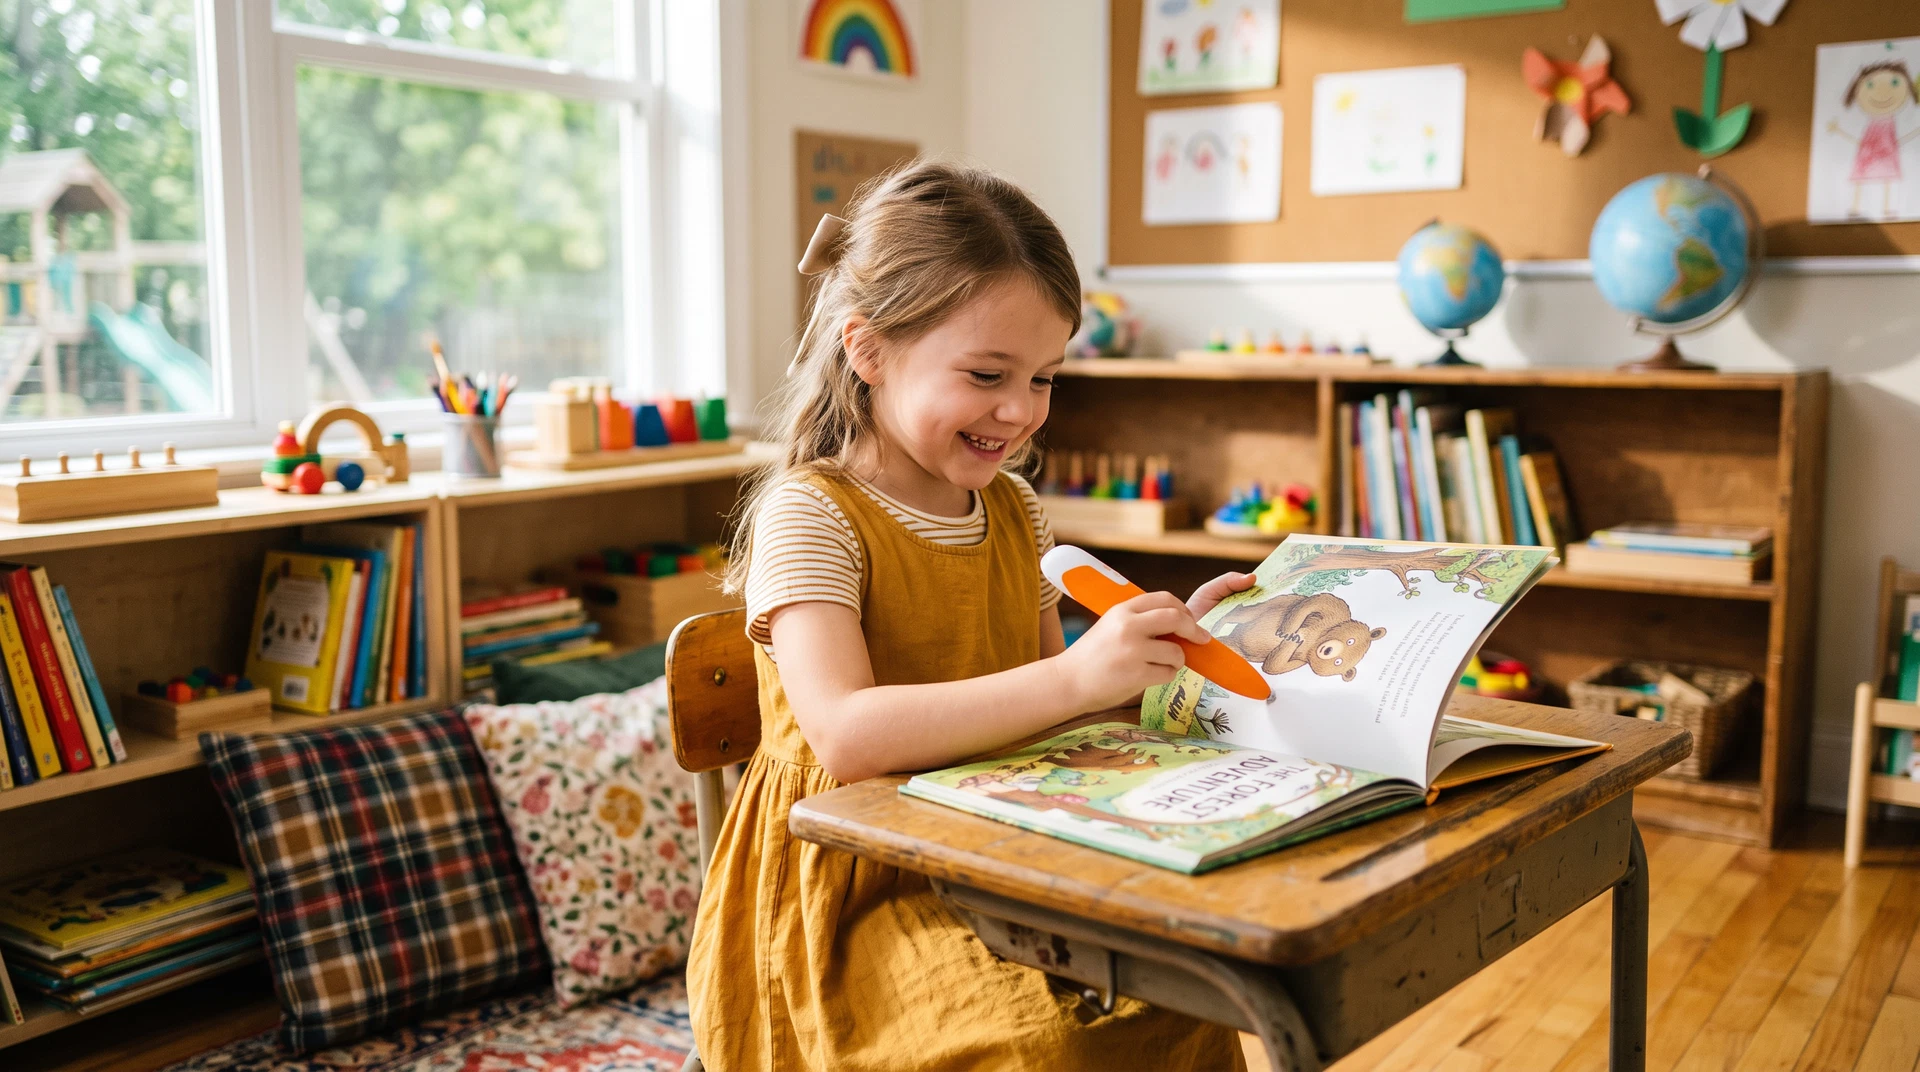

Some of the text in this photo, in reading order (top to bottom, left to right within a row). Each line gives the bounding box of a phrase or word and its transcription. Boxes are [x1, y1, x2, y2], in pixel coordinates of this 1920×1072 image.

[1143, 754, 1279, 812] ADVENTURE
[1181, 765, 1310, 820] THE FOREST
